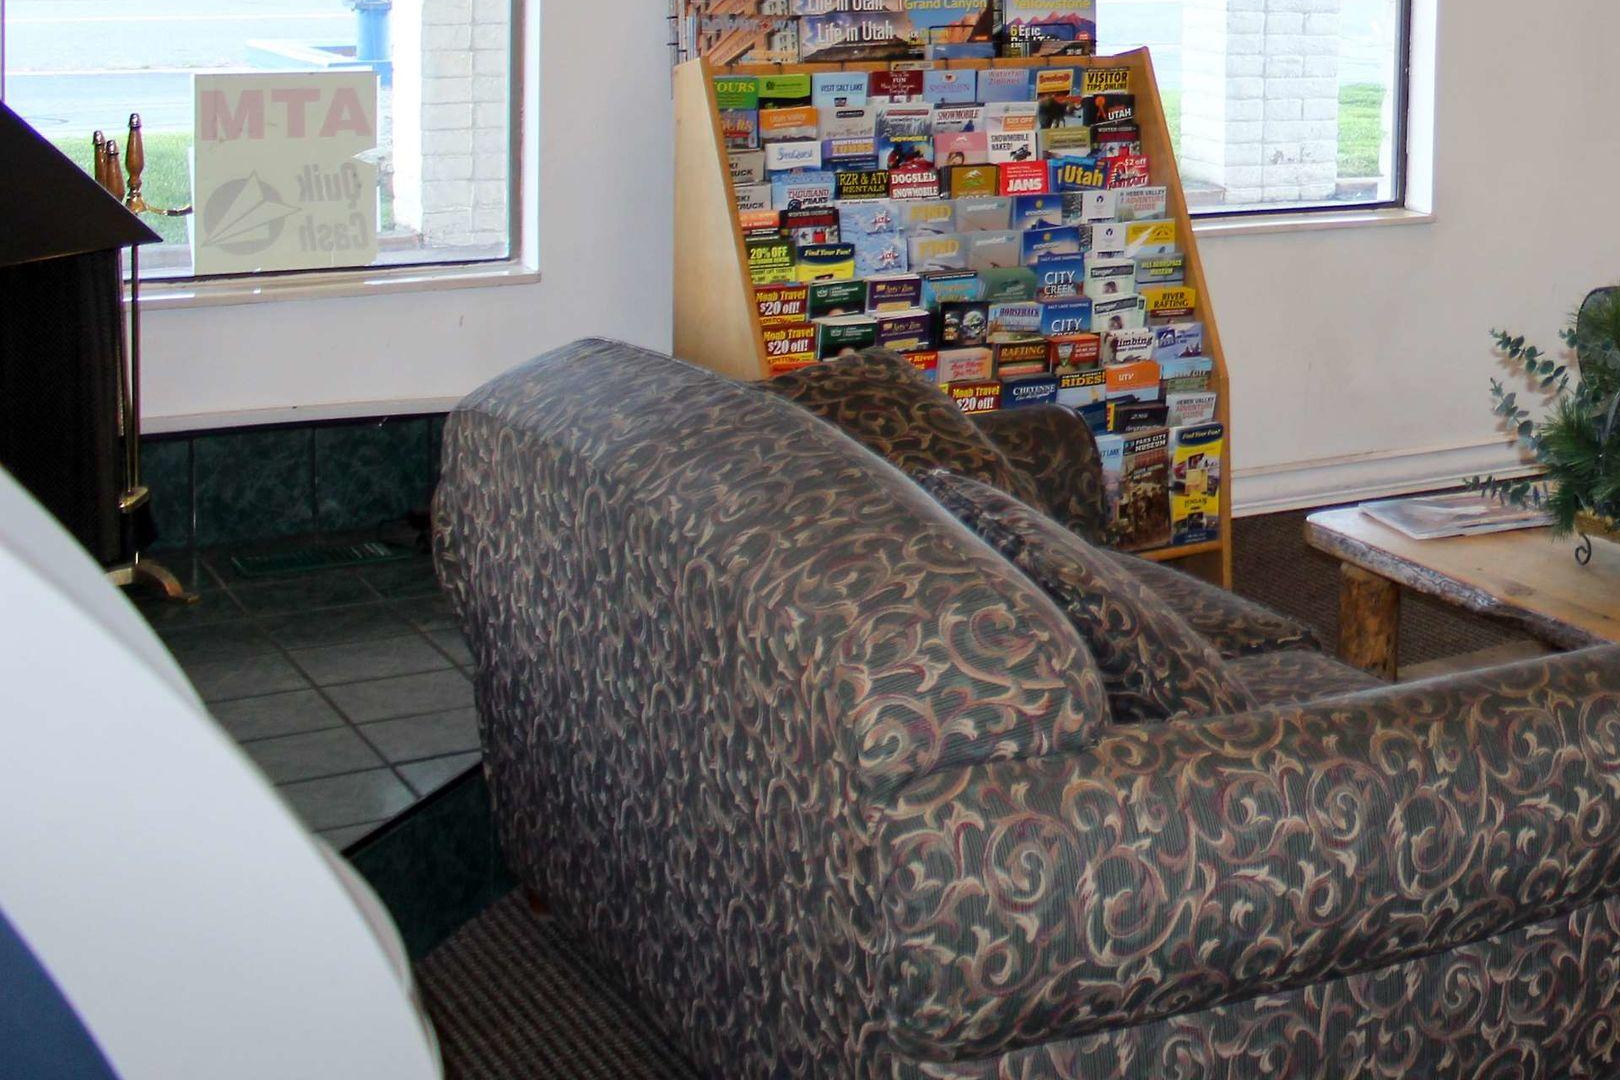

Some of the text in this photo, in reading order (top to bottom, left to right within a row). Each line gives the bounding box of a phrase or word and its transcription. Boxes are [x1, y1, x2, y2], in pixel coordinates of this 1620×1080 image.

[817, 21, 894, 43] Life in Utah
[1010, 25, 1041, 38] 6 Epic
[1087, 71, 1128, 84] VISITOR
[820, 83, 864, 93] VISIT SALT LAKE
[1087, 82, 1127, 91] TIPS ONLINE
[937, 109, 979, 121] SNOWMOBILE
[1108, 108, 1132, 120] UTAH
[990, 133, 1029, 142] SNOWMOBILE
[1123, 158, 1147, 167] $2 off
[839, 172, 889, 186] RZR & ATV
[891, 172, 937, 184] DOGSLED
[1064, 164, 1105, 187] Utah
[842, 184, 886, 194] RENTALS
[1007, 178, 1043, 192] JANS
[787, 188, 830, 199] THOUSAND
[892, 185, 939, 199] SNOWMOBILE
[801, 197, 829, 206] PEAKS
[750, 246, 789, 259] 20% OFF
[804, 249, 820, 257] Find
[820, 248, 836, 256] Your
[1044, 270, 1076, 285] CITY
[756, 289, 806, 302] Moab Travel
[1044, 284, 1076, 296] CREEK
[1162, 292, 1185, 301] RIVER
[759, 298, 800, 315] $20 off!
[1154, 299, 1189, 309] RAFTING
[1051, 318, 1083, 332] CITY
[764, 327, 815, 340] Moab Travel
[768, 338, 808, 355] $20 off!
[1001, 346, 1045, 357] RAFTING
[913, 354, 937, 362] River
[1061, 373, 1106, 388] RIDES!
[1118, 373, 1134, 382] UTV
[953, 385, 1000, 398] Moab Travel
[1012, 384, 1056, 396] CHEYENNE
[957, 396, 995, 411] $20 off!
[1194, 396, 1215, 404] VALLEY
[1135, 434, 1166, 446] PARK CITY
[1135, 439, 1166, 453] MUSEUM
[1106, 449, 1120, 457] LAKE
